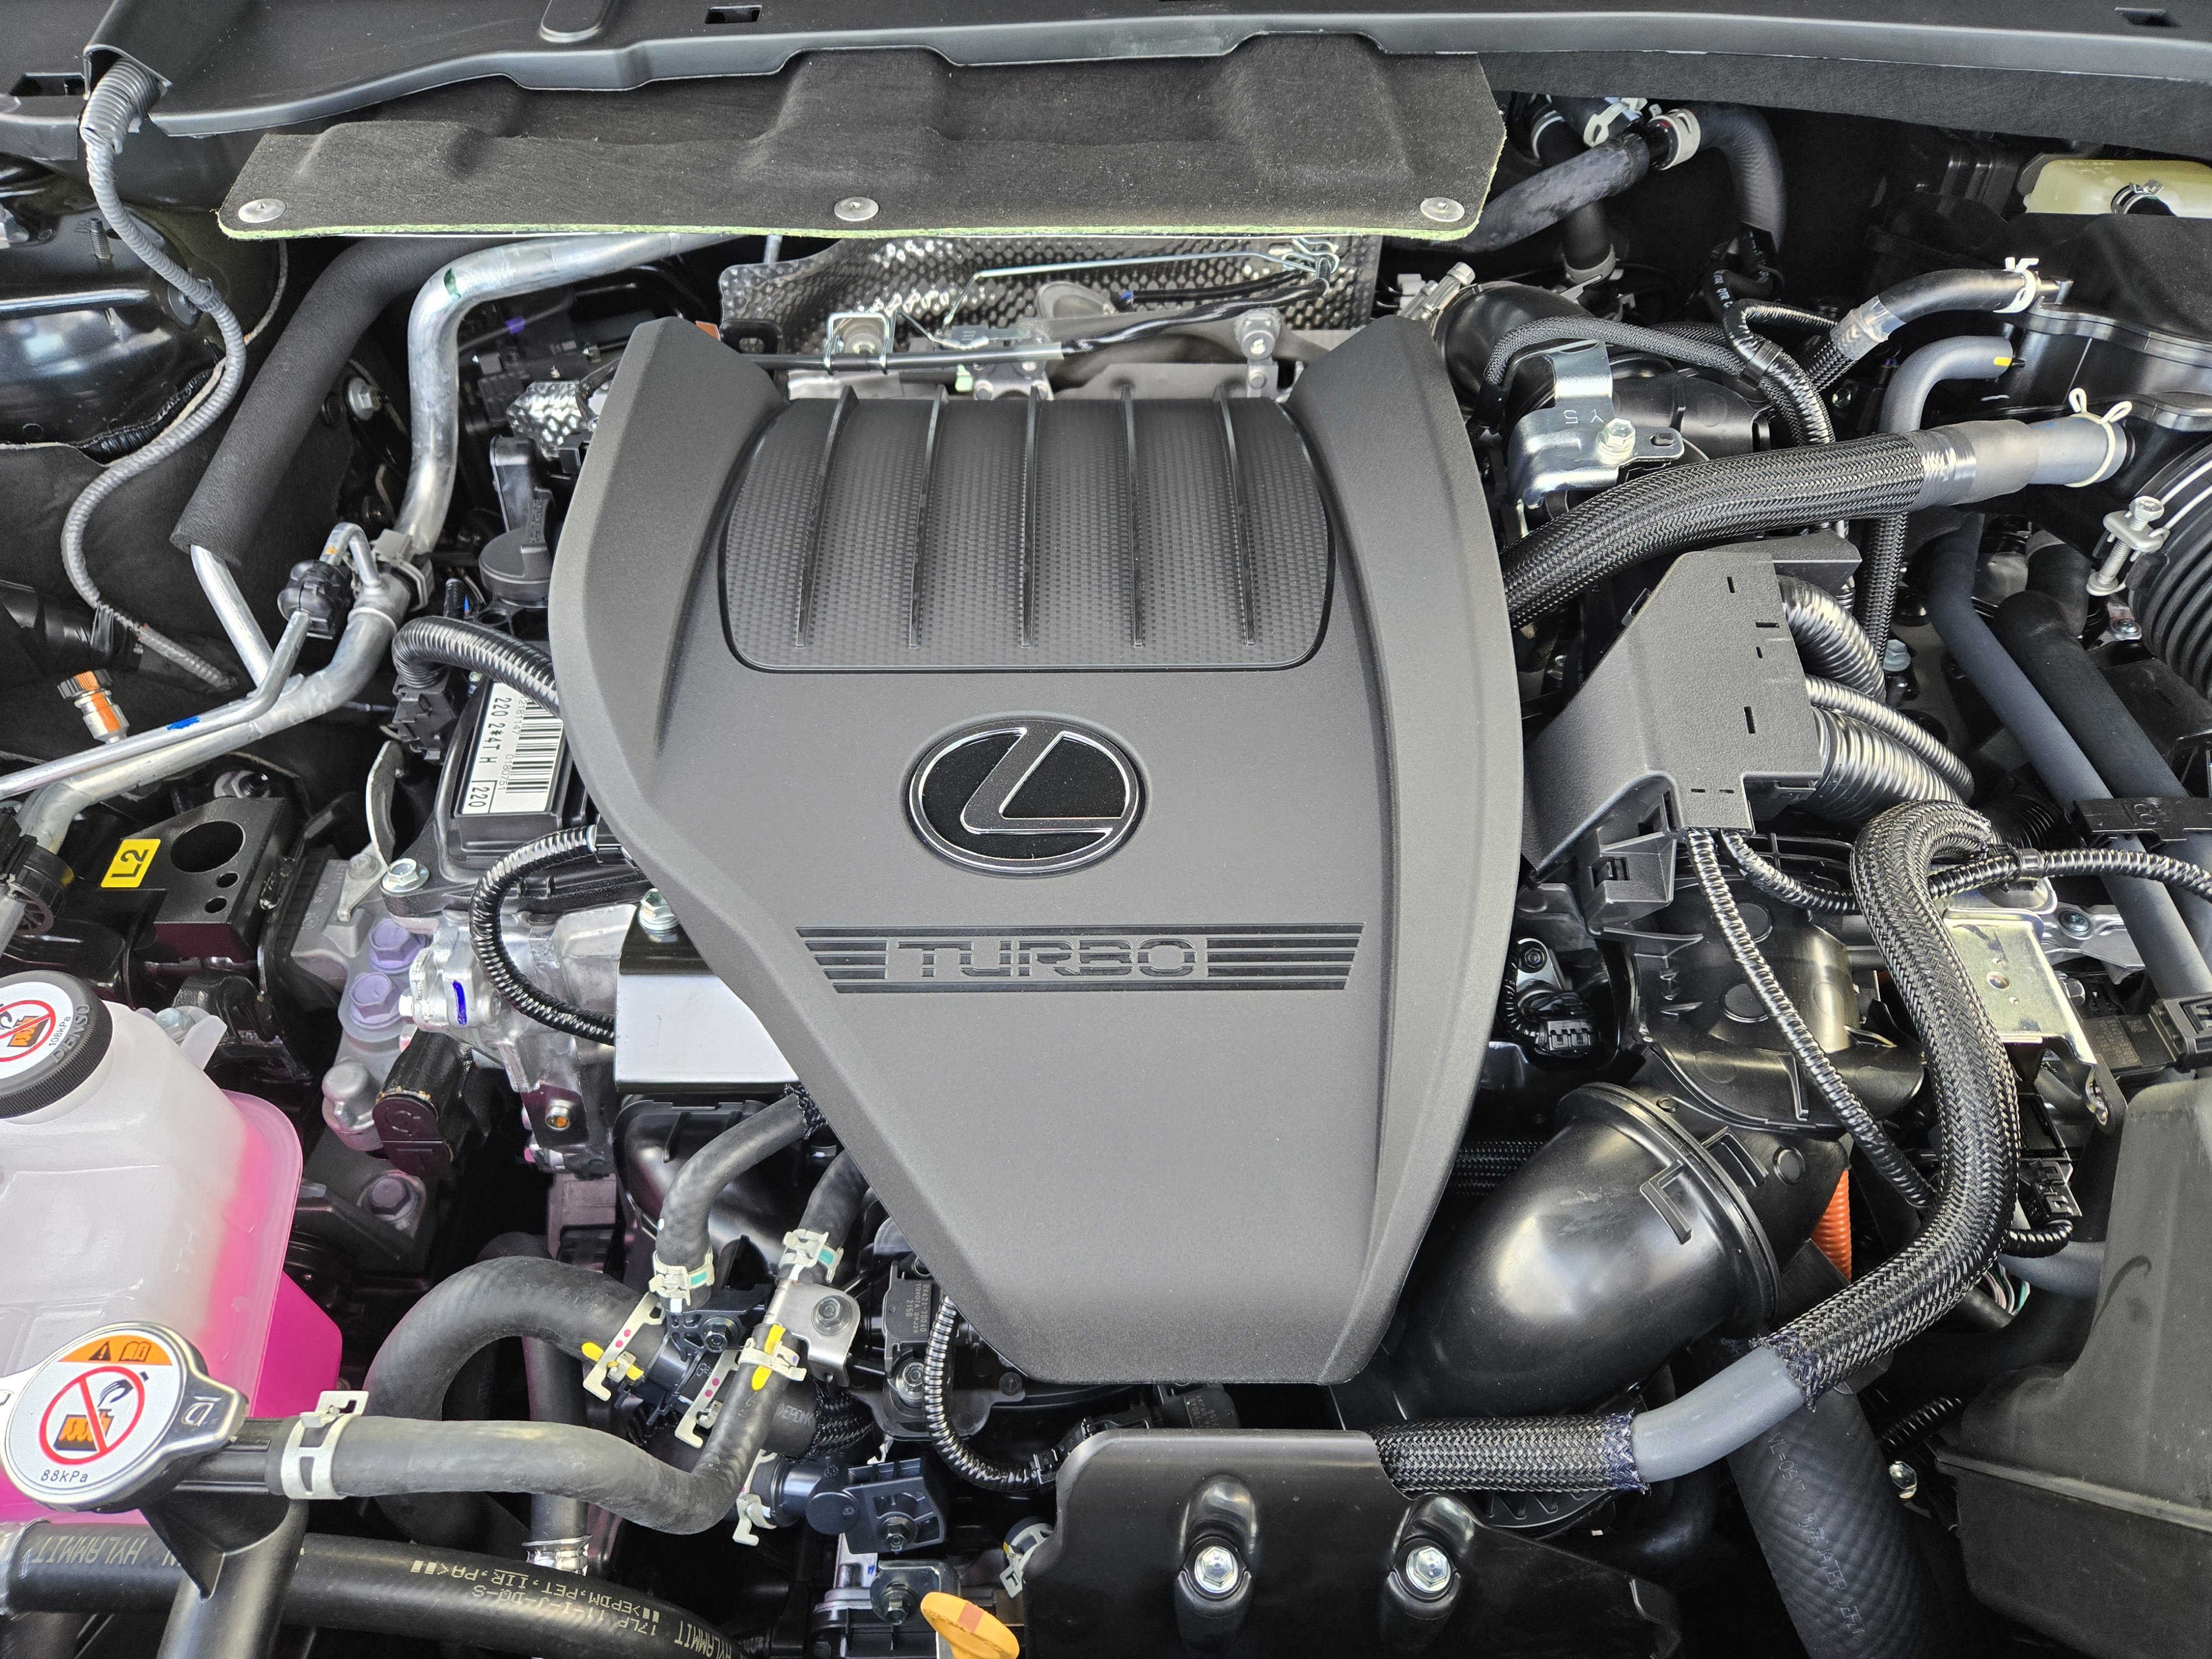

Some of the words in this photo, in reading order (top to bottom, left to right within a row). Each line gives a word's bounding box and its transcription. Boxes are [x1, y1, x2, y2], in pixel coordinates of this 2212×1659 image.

[491, 697, 512, 717] 220
[498, 754, 514, 790] 0180751
[468, 786, 491, 807] 220
[111, 849, 149, 878] L2
[896, 939, 1195, 977] TURBO
[49, 1017, 71, 1046] 108kPa
[54, 1004, 90, 1063] DENSO
[920, 1284, 930, 1332] 89421-78040
[40, 1469, 88, 1483] 88kPa
[30, 1536, 148, 1565] HYLAMMIT
[619, 1618, 656, 1636] 17LP
